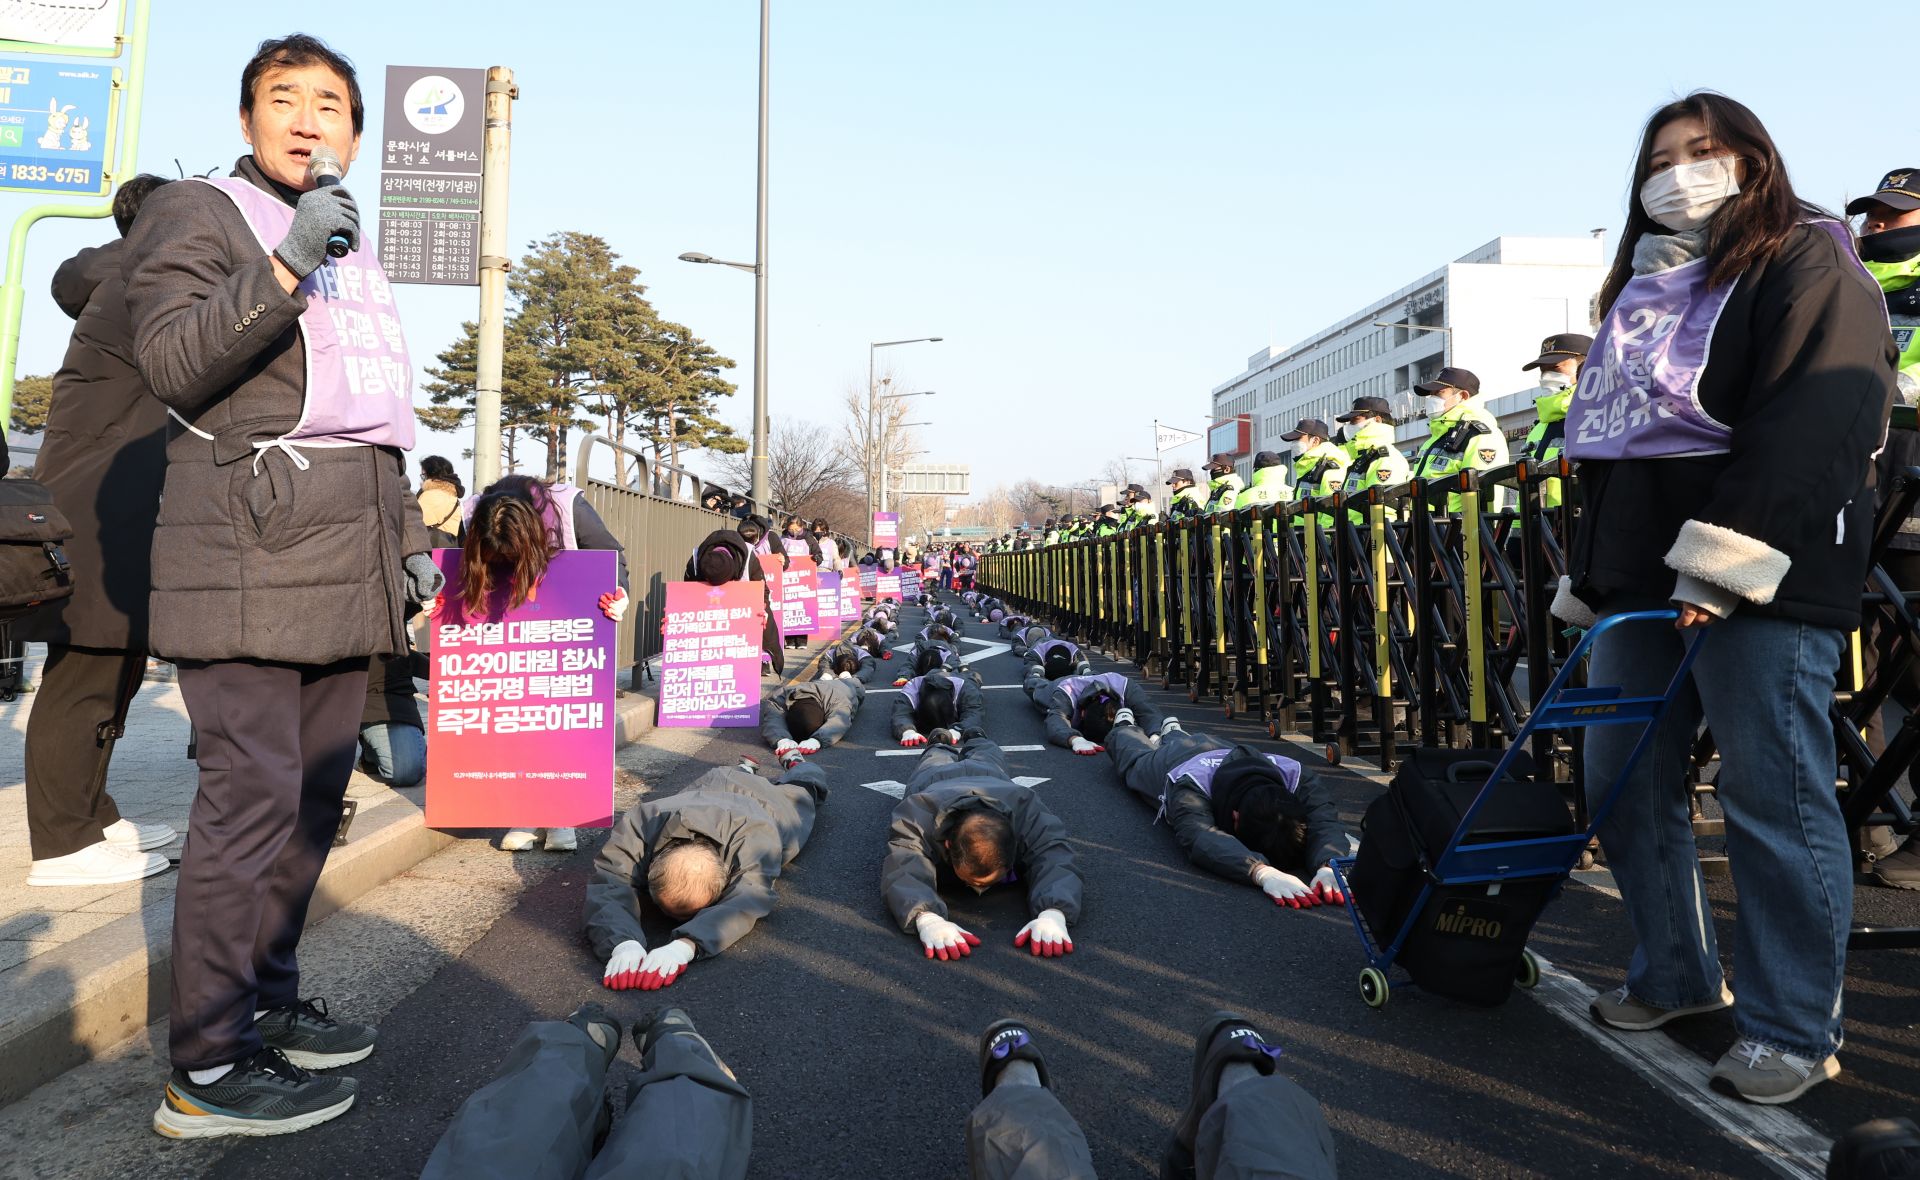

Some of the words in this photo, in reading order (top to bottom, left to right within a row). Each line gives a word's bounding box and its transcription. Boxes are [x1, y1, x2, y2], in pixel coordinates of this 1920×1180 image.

[387, 140, 430, 153] 문화시설
[434, 150, 479, 162] 셔틀버스
[11, 164, 90, 184] 1833-6751
[384, 177, 477, 193] 삼각지역(전쟁기념관)
[667, 611, 695, 624] 10.29
[696, 609, 729, 622] 이태원
[730, 607, 752, 620] 참사
[438, 622, 505, 648] 윤석열
[508, 618, 595, 644] 대통령은
[667, 620, 730, 635] 유가족입니다
[666, 637, 700, 651] 윤석열
[438, 648, 558, 676] 10.29이태원
[561, 647, 606, 672] 참사
[665, 650, 699, 663] 이태원
[700, 648, 723, 661] 참사
[725, 645, 759, 658] 특별법
[438, 676, 525, 703] 진상규명
[528, 673, 593, 699] 특별법
[663, 682, 691, 698] 먼저
[693, 679, 736, 696] 만나고
[662, 693, 746, 714] 결정하십시오
[1573, 705, 1617, 715] IKEA
[436, 706, 491, 735] 즉각
[493, 702, 604, 734] 공포하라!
